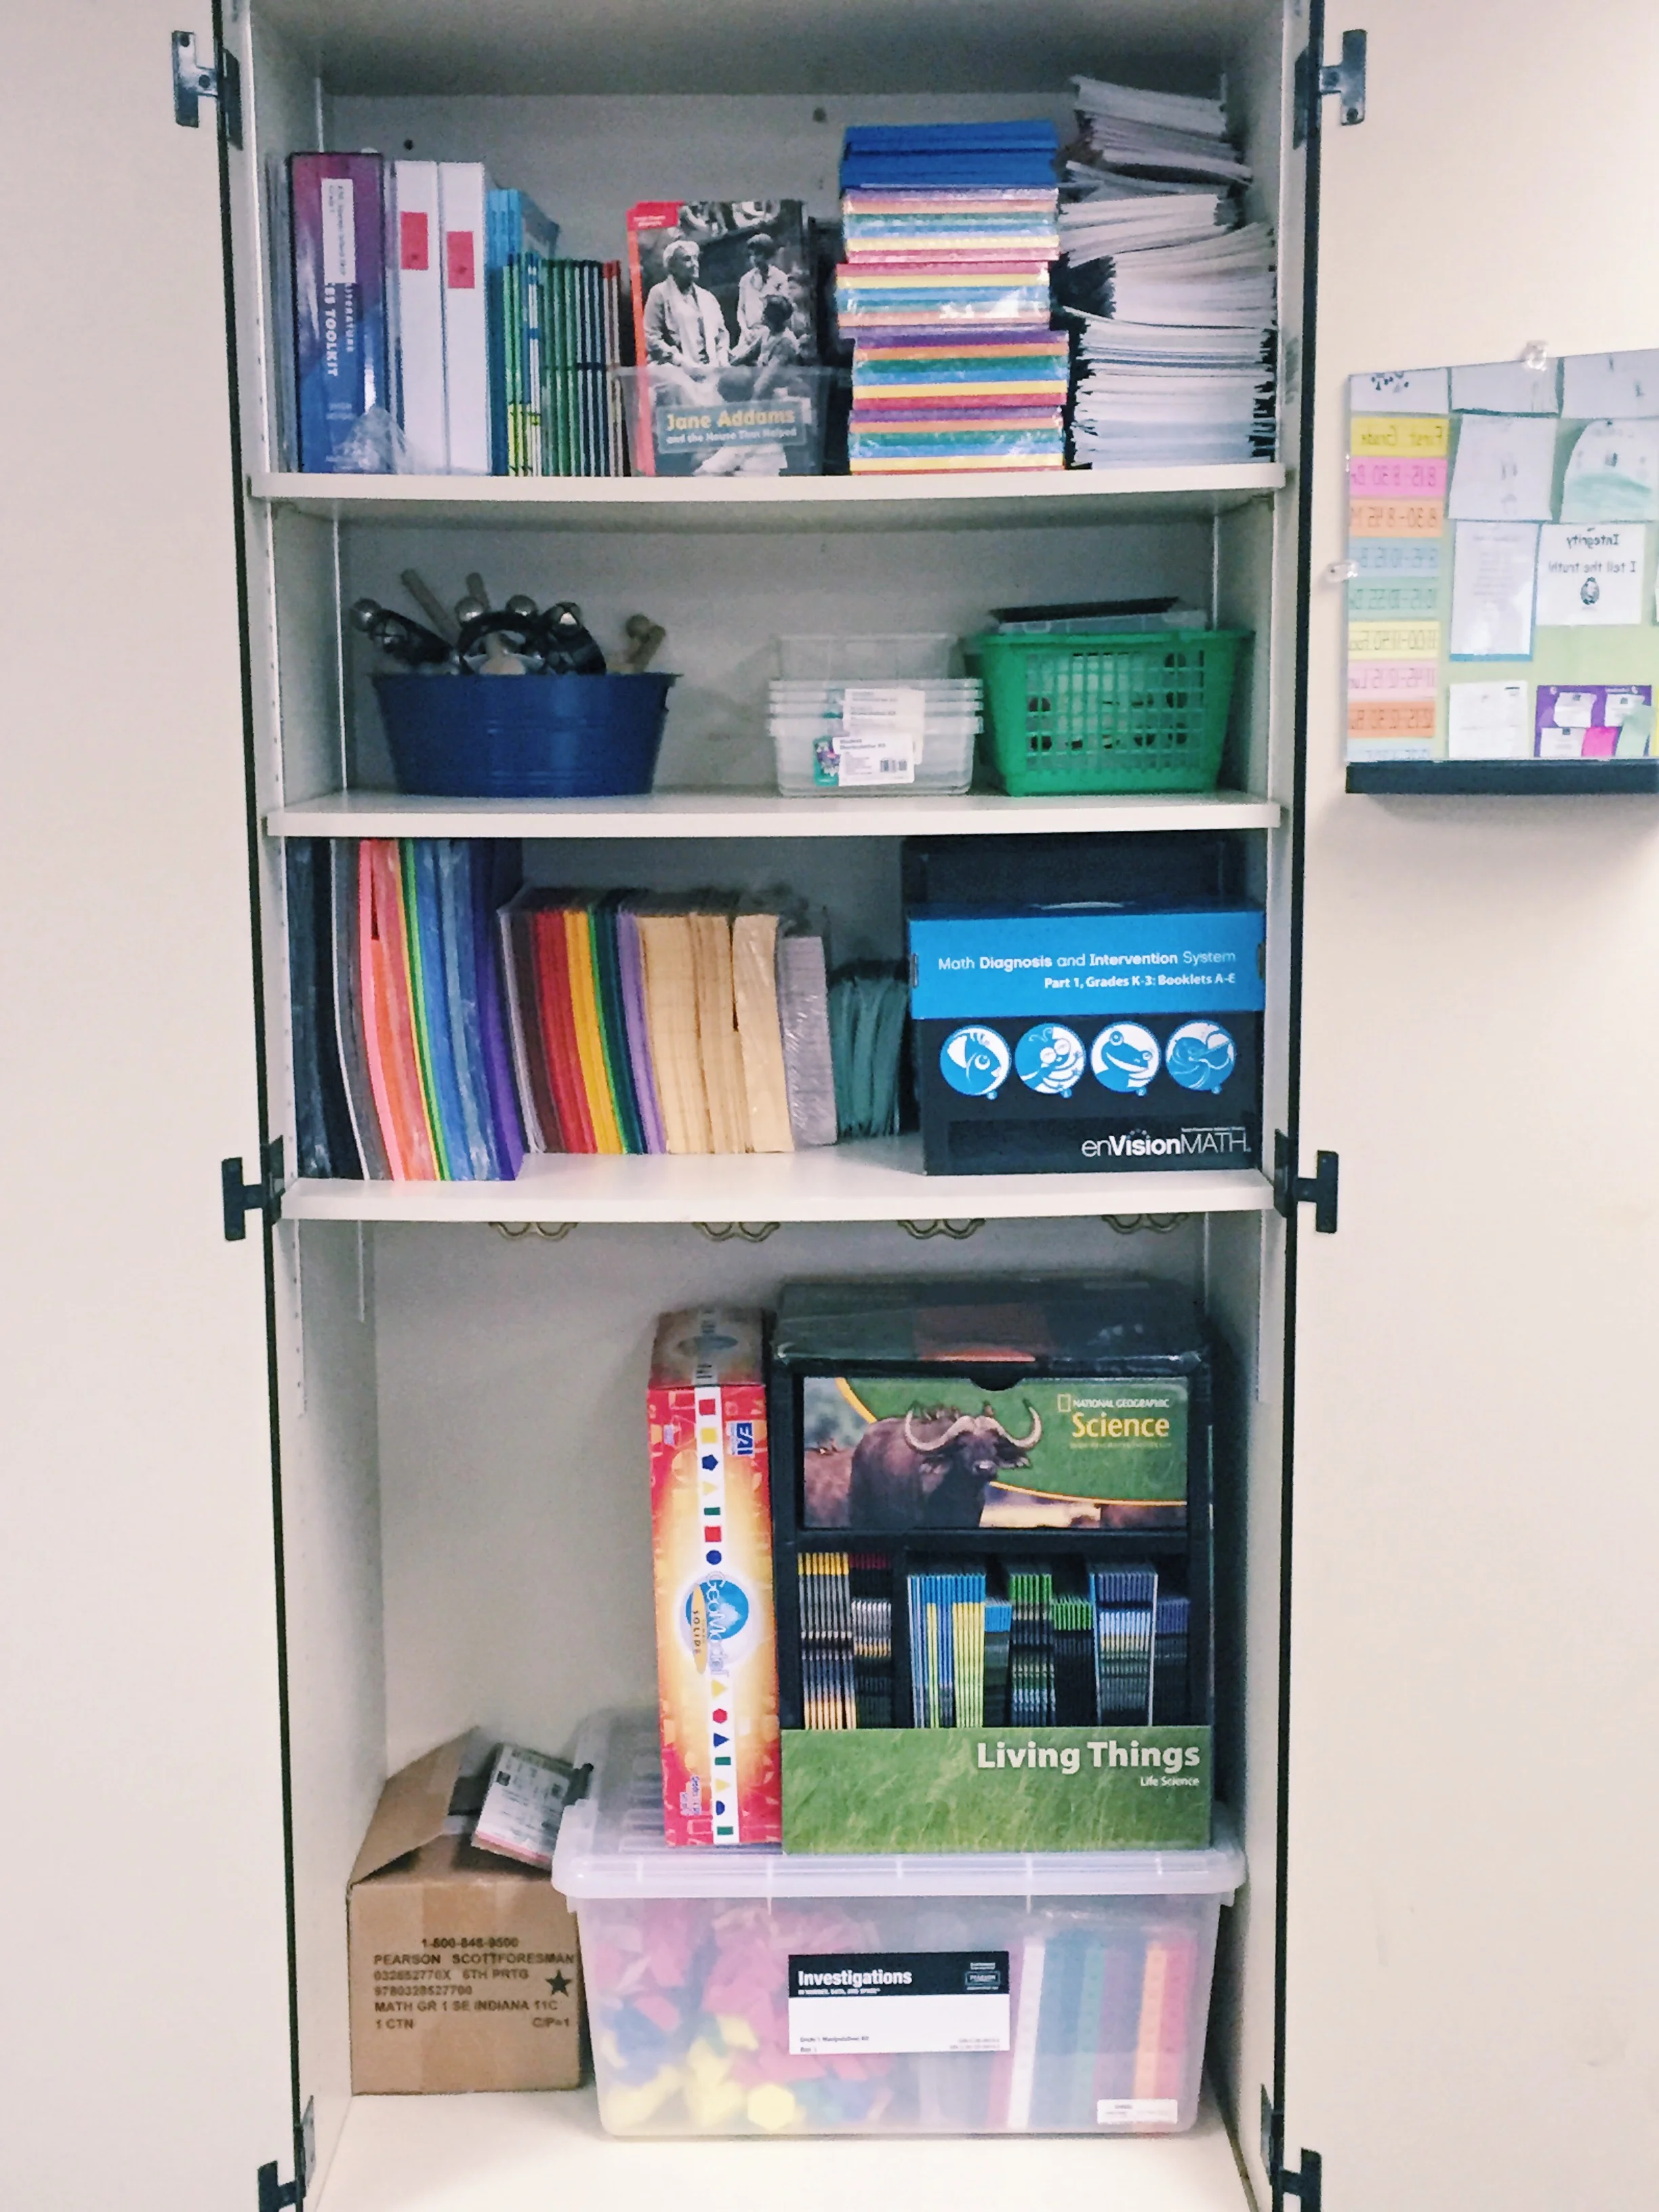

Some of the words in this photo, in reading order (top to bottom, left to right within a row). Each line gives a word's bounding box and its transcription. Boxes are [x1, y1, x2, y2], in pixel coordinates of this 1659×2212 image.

[325, 308, 338, 377] TOOLKIT
[666, 413, 711, 432] Jane
[717, 409, 796, 427] Addams
[666, 434, 686, 445] and
[687, 432, 704, 443] the
[938, 956, 975, 970] Math
[979, 956, 1052, 972] Diagnosis
[1057, 954, 1086, 966] and
[1089, 952, 1178, 966] Intervention
[1183, 951, 1236, 966] System
[1044, 977, 1070, 989] Part
[1073, 977, 1084, 989] 1,
[1085, 975, 1130, 987] Grades
[1132, 975, 1155, 986] K-3:
[1158, 973, 1212, 985] Booklets
[1214, 972, 1236, 983] A-E
[1081, 1129, 1248, 1158] enVisionMATH
[1073, 1399, 1114, 1408] NATIONAL
[1115, 1399, 1170, 1408] GEOGRAPHIC
[1072, 1412, 1170, 1438] Science
[977, 1741, 1080, 1774] Living
[1086, 1740, 1200, 1774] Things
[1141, 1776, 1158, 1786] Life
[1161, 1776, 1200, 1786] Science
[374, 1953, 441, 1965] PEARSON
[452, 1952, 575, 1965] SCOTTFORESMAN
[493, 1968, 529, 1980] PRTG
[798, 1969, 913, 1987] Investigations
[375, 2001, 413, 2012] MATH
[417, 2000, 437, 2011] GR
[442, 2001, 448, 2011] 1
[453, 2001, 470, 2011] SE
[474, 2000, 530, 2011] INDIANA
[535, 1999, 558, 2011] 11C
[376, 2019, 382, 2029] 1
[386, 2019, 414, 2029] CTN
